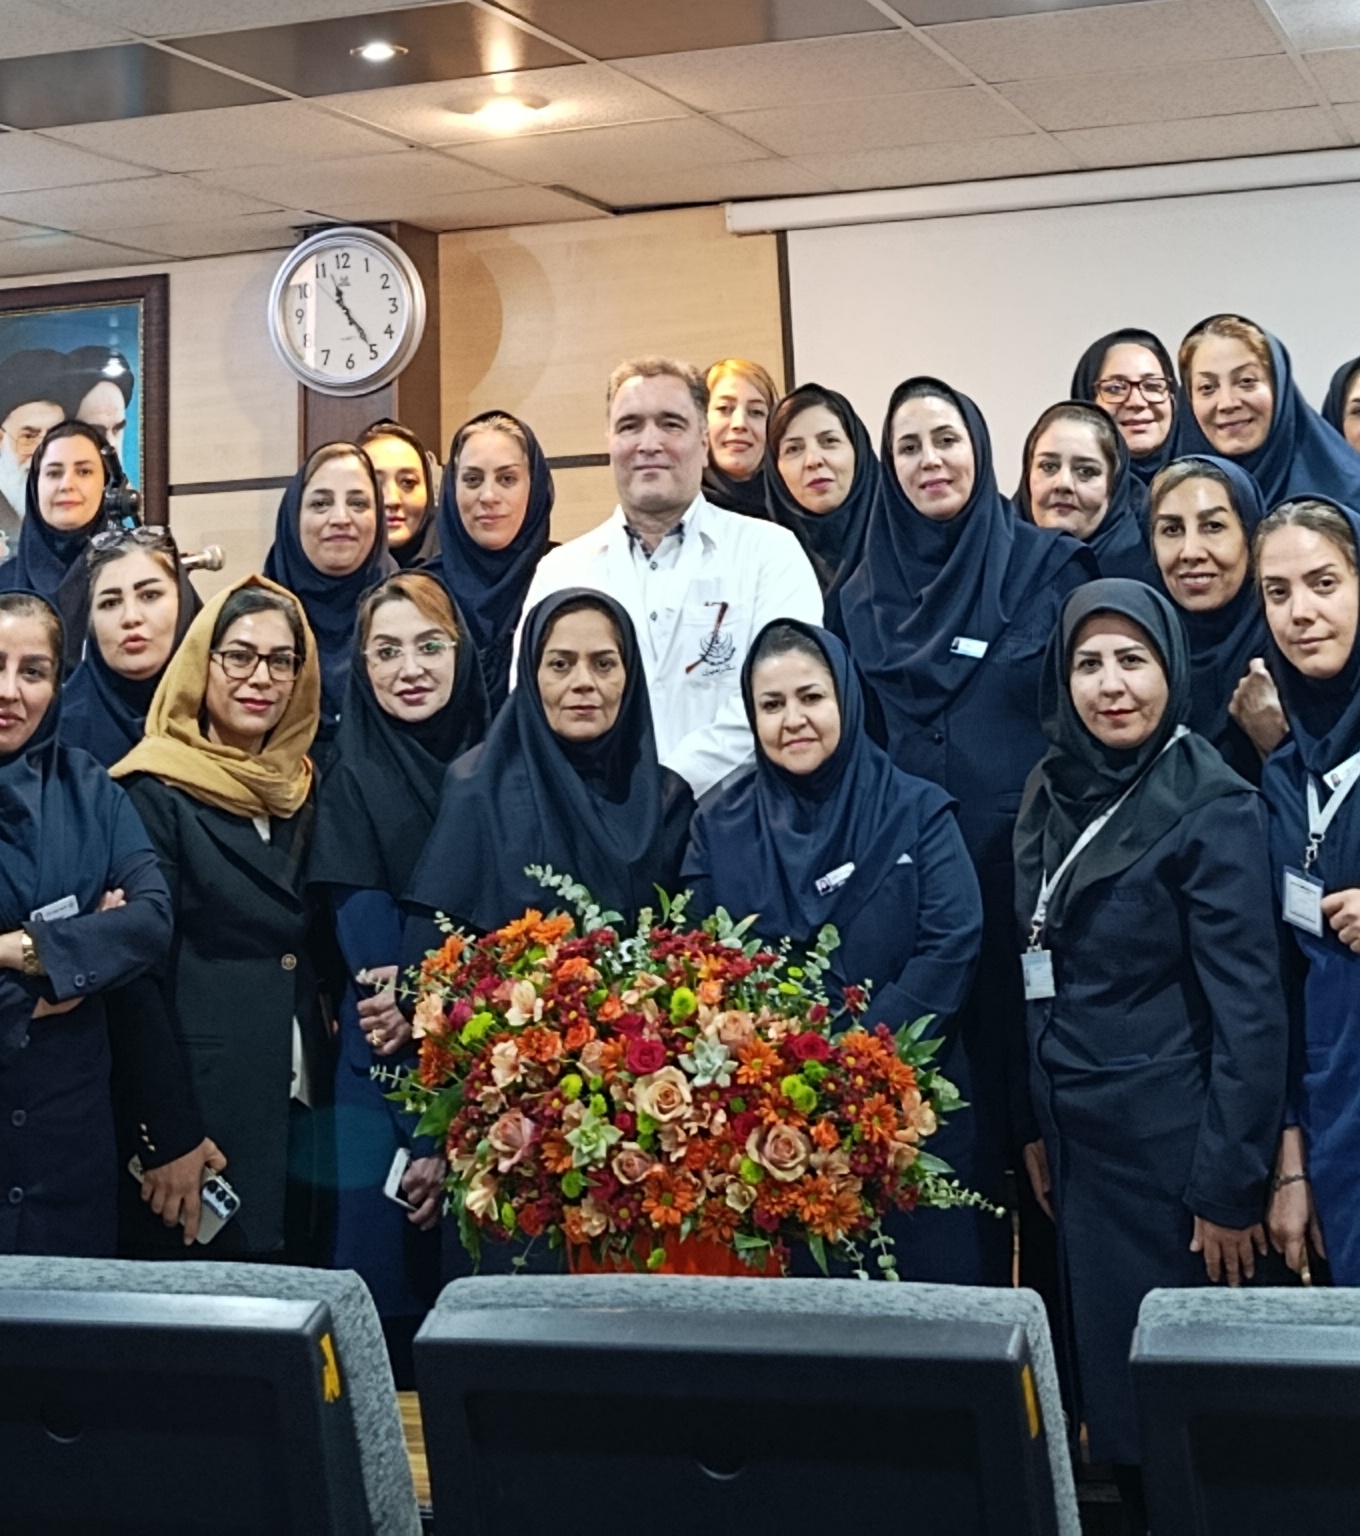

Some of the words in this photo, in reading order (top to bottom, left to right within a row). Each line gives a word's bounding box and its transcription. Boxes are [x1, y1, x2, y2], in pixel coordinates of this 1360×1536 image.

[335, 252, 351, 270] 12
[364, 257, 369, 273] 1
[315, 262, 327, 279] 11
[380, 273, 390, 290] 2
[297, 282, 313, 300] 10
[388, 297, 399, 314] 3
[295, 308, 305, 325] 9
[383, 324, 394, 340] 4
[303, 333, 313, 349] 8
[321, 349, 331, 366] 7
[368, 344, 379, 361] 5
[345, 353, 355, 370] 6
